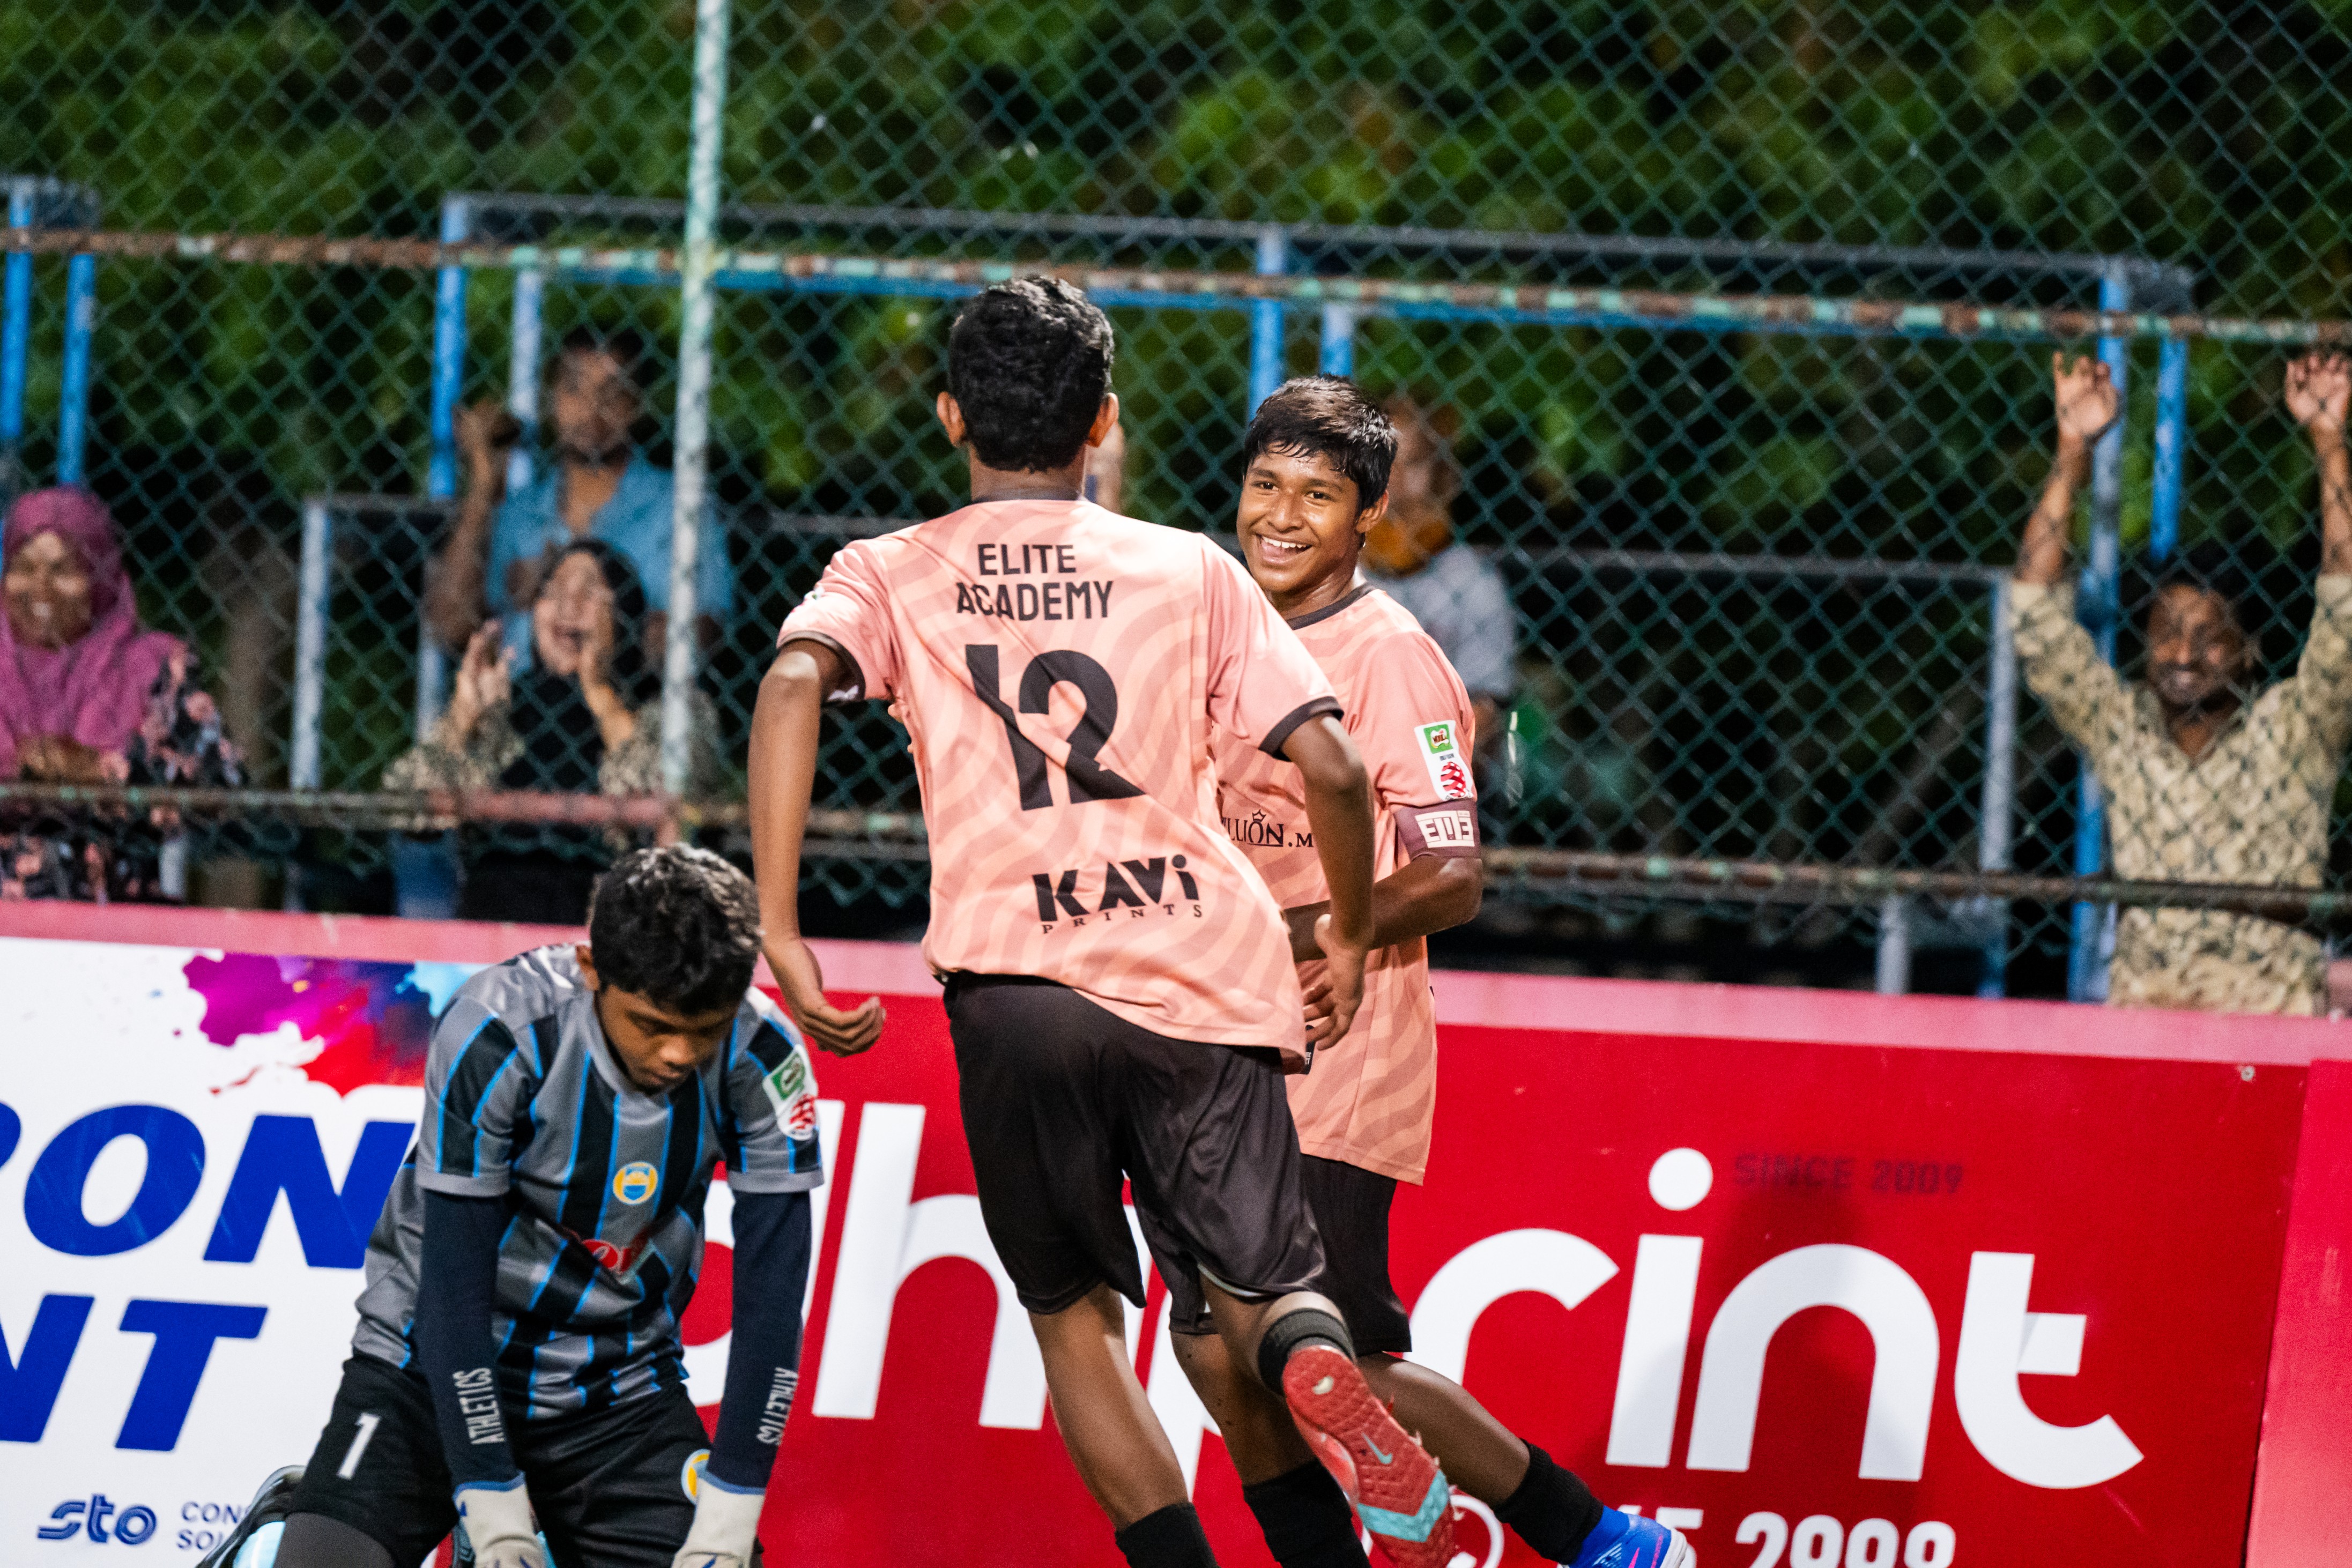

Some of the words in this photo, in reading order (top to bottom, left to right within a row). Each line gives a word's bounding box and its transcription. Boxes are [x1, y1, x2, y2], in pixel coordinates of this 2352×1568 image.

[977, 543, 1077, 576] ELITE
[955, 580, 1114, 621] ACADEMY
[964, 644, 1146, 811] 12
[1042, 904, 1203, 934] PRINTS
[1734, 1153, 1854, 1189] SINCE
[1873, 1158, 1963, 1194] 2009
[452, 1368, 505, 1444] ATHLETICS
[756, 1367, 798, 1445] ATHLETICS
[338, 1413, 381, 1479] 1
[181, 1501, 250, 1524] CON
